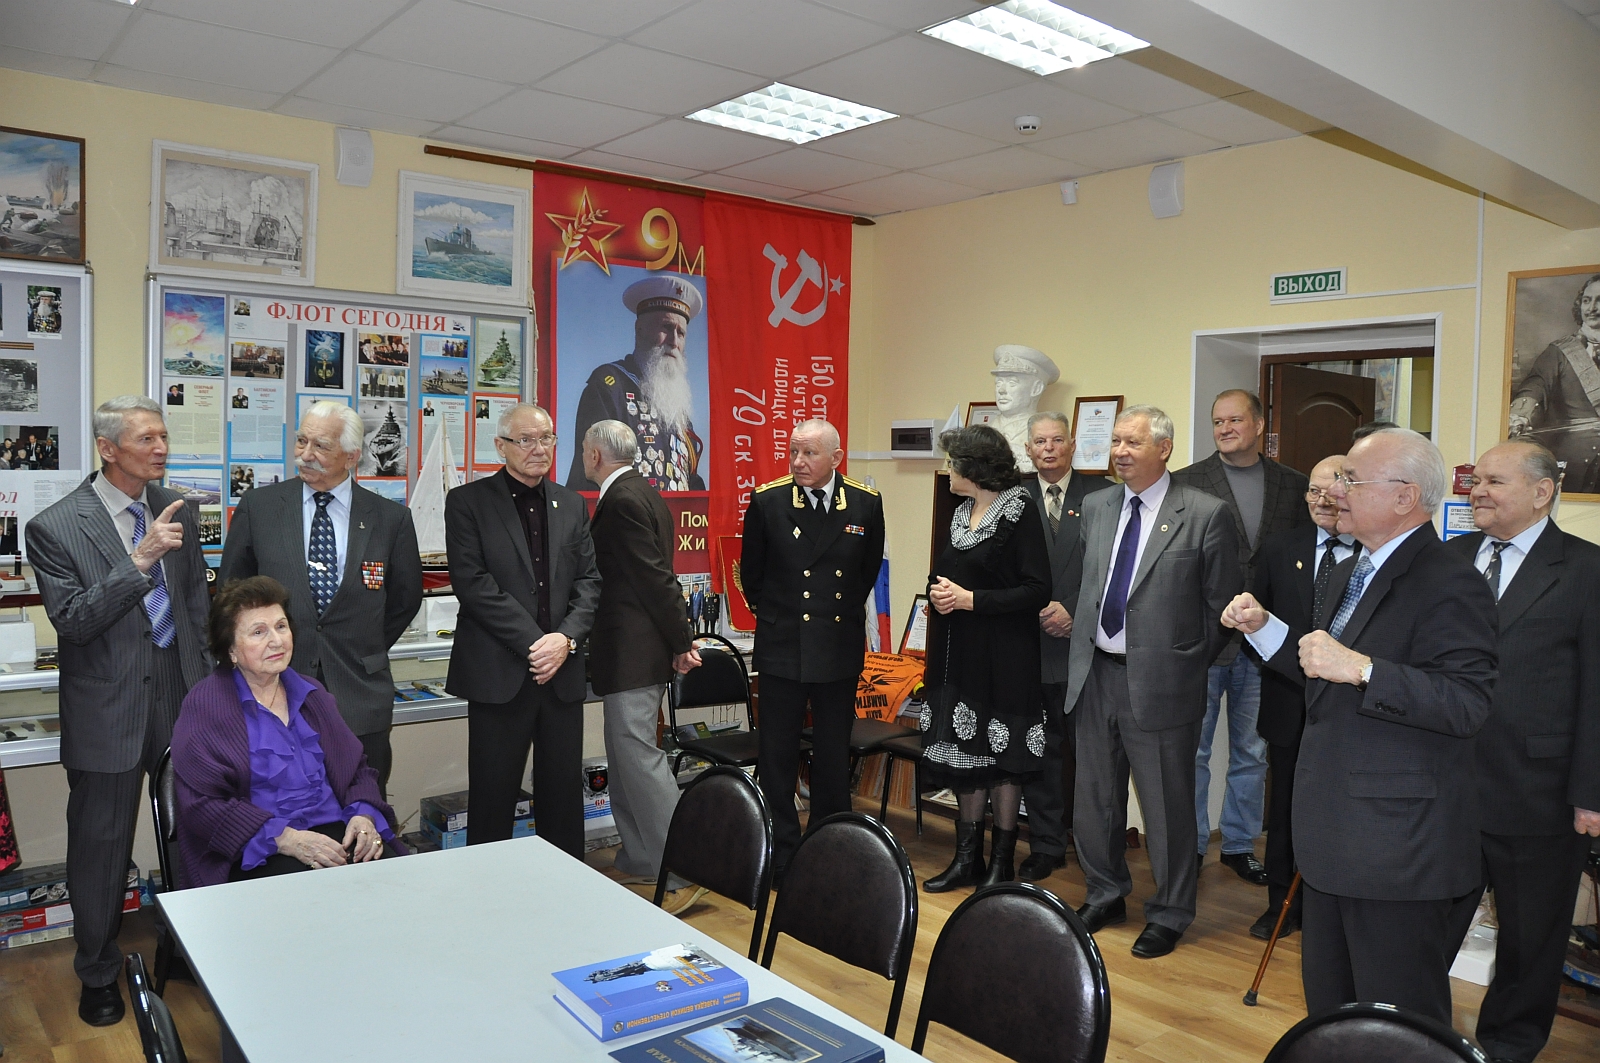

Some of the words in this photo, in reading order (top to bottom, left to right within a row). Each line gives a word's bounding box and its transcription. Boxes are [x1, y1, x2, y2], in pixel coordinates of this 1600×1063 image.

[641, 207, 678, 270] 9
[1277, 271, 1340, 295] ВЫХОД
[267, 302, 336, 323] ФЛОТ
[341, 308, 447, 332] СЕГОДНЯ
[810, 355, 835, 387] 150
[771, 357, 789, 423] ИДРИЦК.
[732, 387, 766, 426] 79
[772, 428, 786, 464] ДИВ.
[855, 694, 888, 709] ПАМЯТИ
[626, 1010, 670, 1029] ОТЕЧЕСТВЕННОЙ
[670, 1004, 695, 1018] ВЕЛИКОЙ
[694, 998, 720, 1011] РАЗВЕДКА
